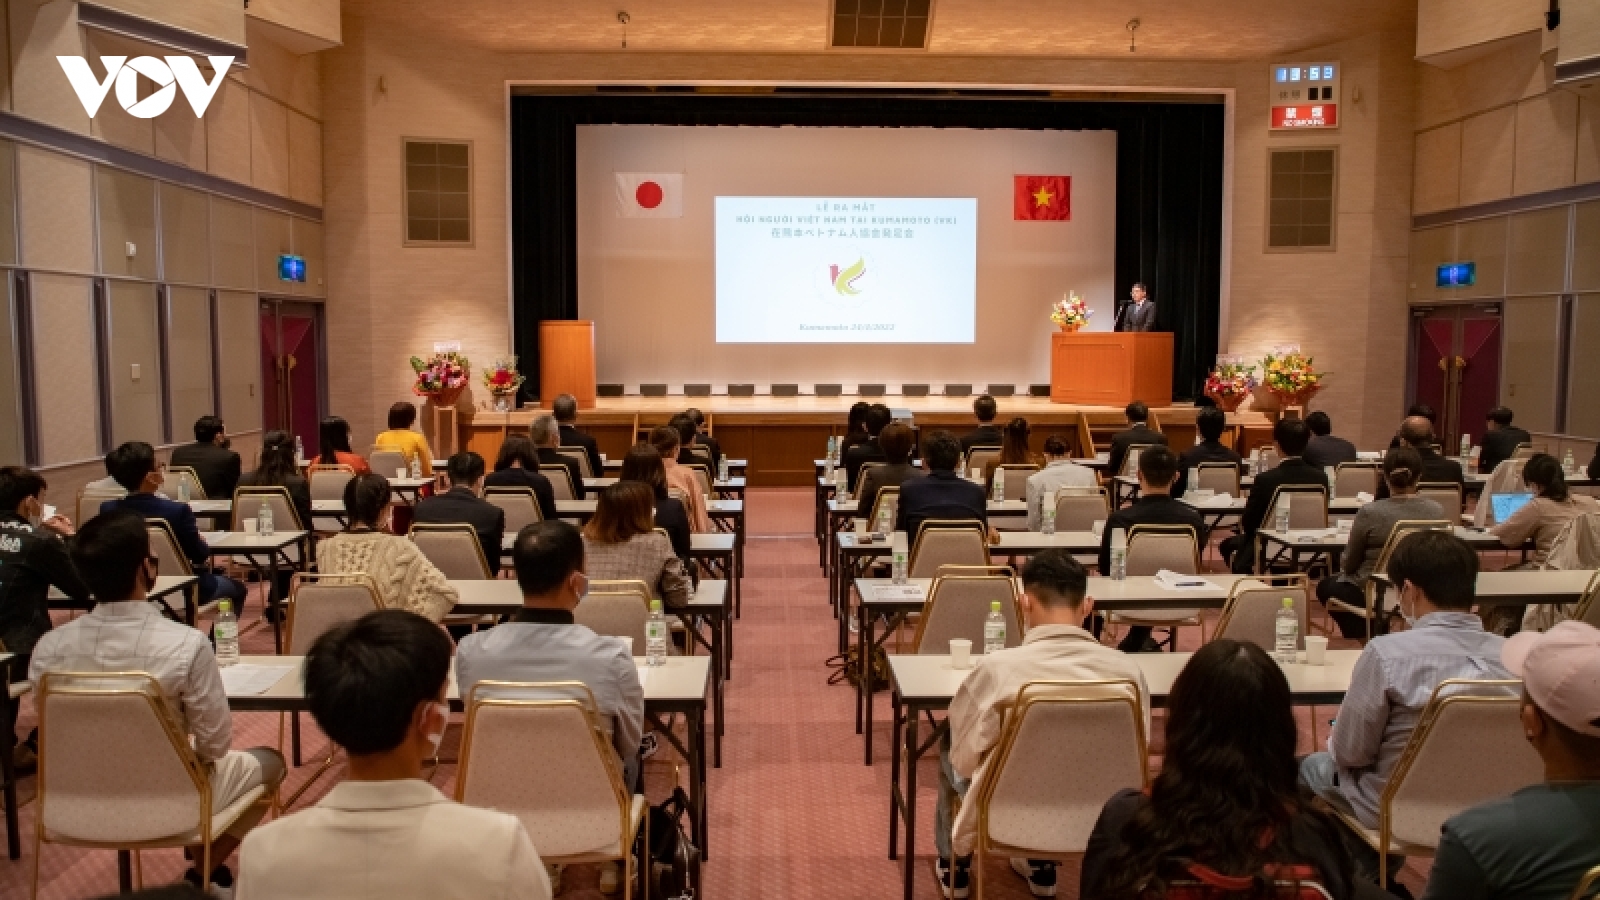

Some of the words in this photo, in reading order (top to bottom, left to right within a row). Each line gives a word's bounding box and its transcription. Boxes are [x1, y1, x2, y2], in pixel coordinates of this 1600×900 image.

[833, 203, 849, 212] RA
[823, 215, 847, 224] NAM
[871, 215, 931, 225] KUMAMOTO
